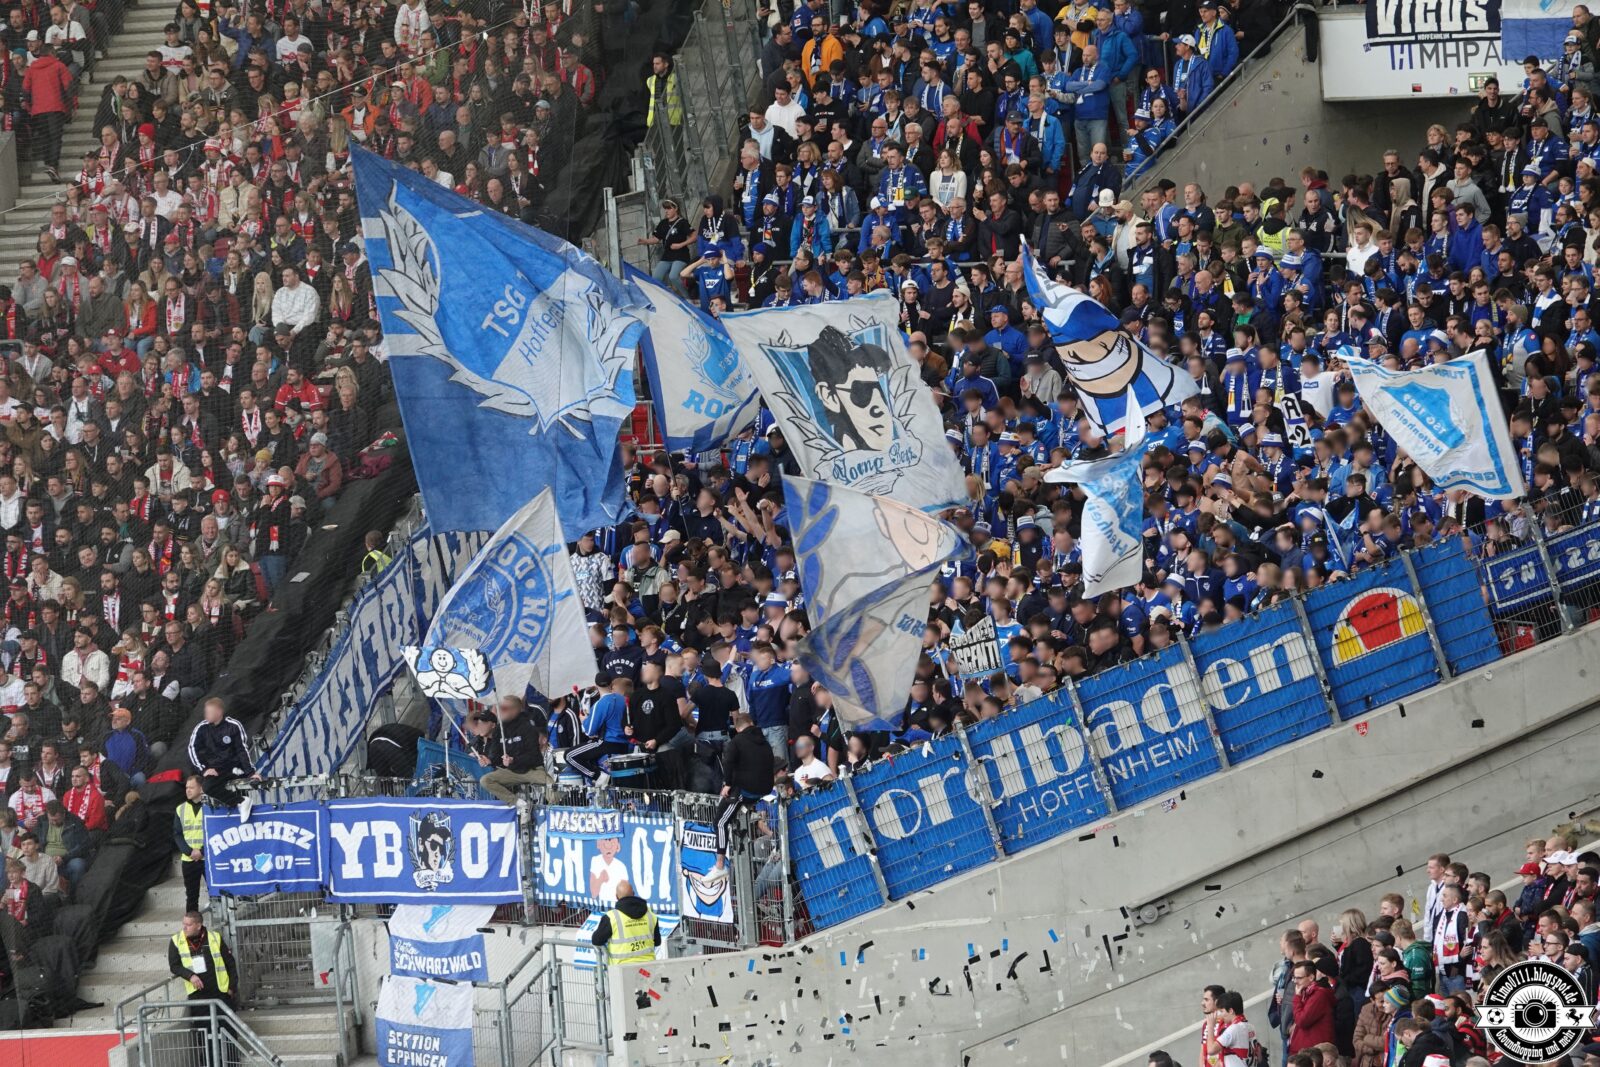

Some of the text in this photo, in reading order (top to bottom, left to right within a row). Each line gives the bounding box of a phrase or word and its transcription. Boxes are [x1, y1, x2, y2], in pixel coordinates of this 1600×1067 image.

[1377, 0, 1489, 35] VICUS
[481, 284, 526, 337] TSG
[807, 631, 1317, 869] nordbaden
[1019, 731, 1200, 823] HOFFENHEIM
[208, 820, 315, 855] ROOKIEZ
[550, 811, 620, 833] NASCENTI
[229, 856, 294, 873] YB 07
[331, 820, 517, 879] YB 07
[631, 826, 674, 902] 07
[394, 951, 482, 975] SCHWARZWALD
[387, 1048, 448, 1067] EPPINGEN
[388, 1030, 441, 1052] SEKTION
